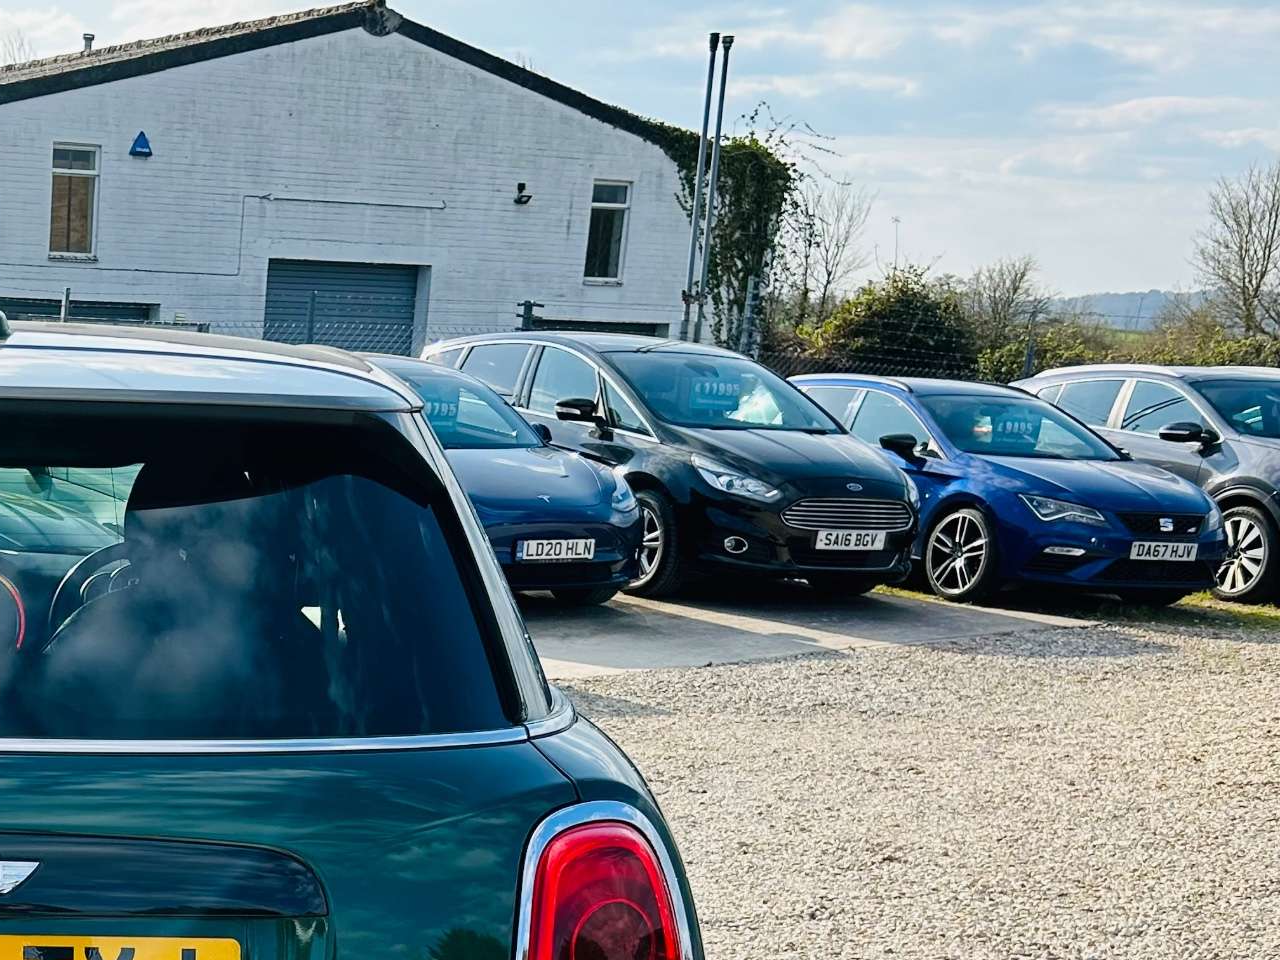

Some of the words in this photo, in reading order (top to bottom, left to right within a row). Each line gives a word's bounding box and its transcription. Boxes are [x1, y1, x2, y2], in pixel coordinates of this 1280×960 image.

[824, 532, 853, 547] SA16
[854, 533, 878, 547] BGV
[526, 542, 562, 557] LD20
[566, 541, 592, 556] HLN
[1136, 544, 1169, 558] DA67
[1170, 545, 1194, 558] HJV
